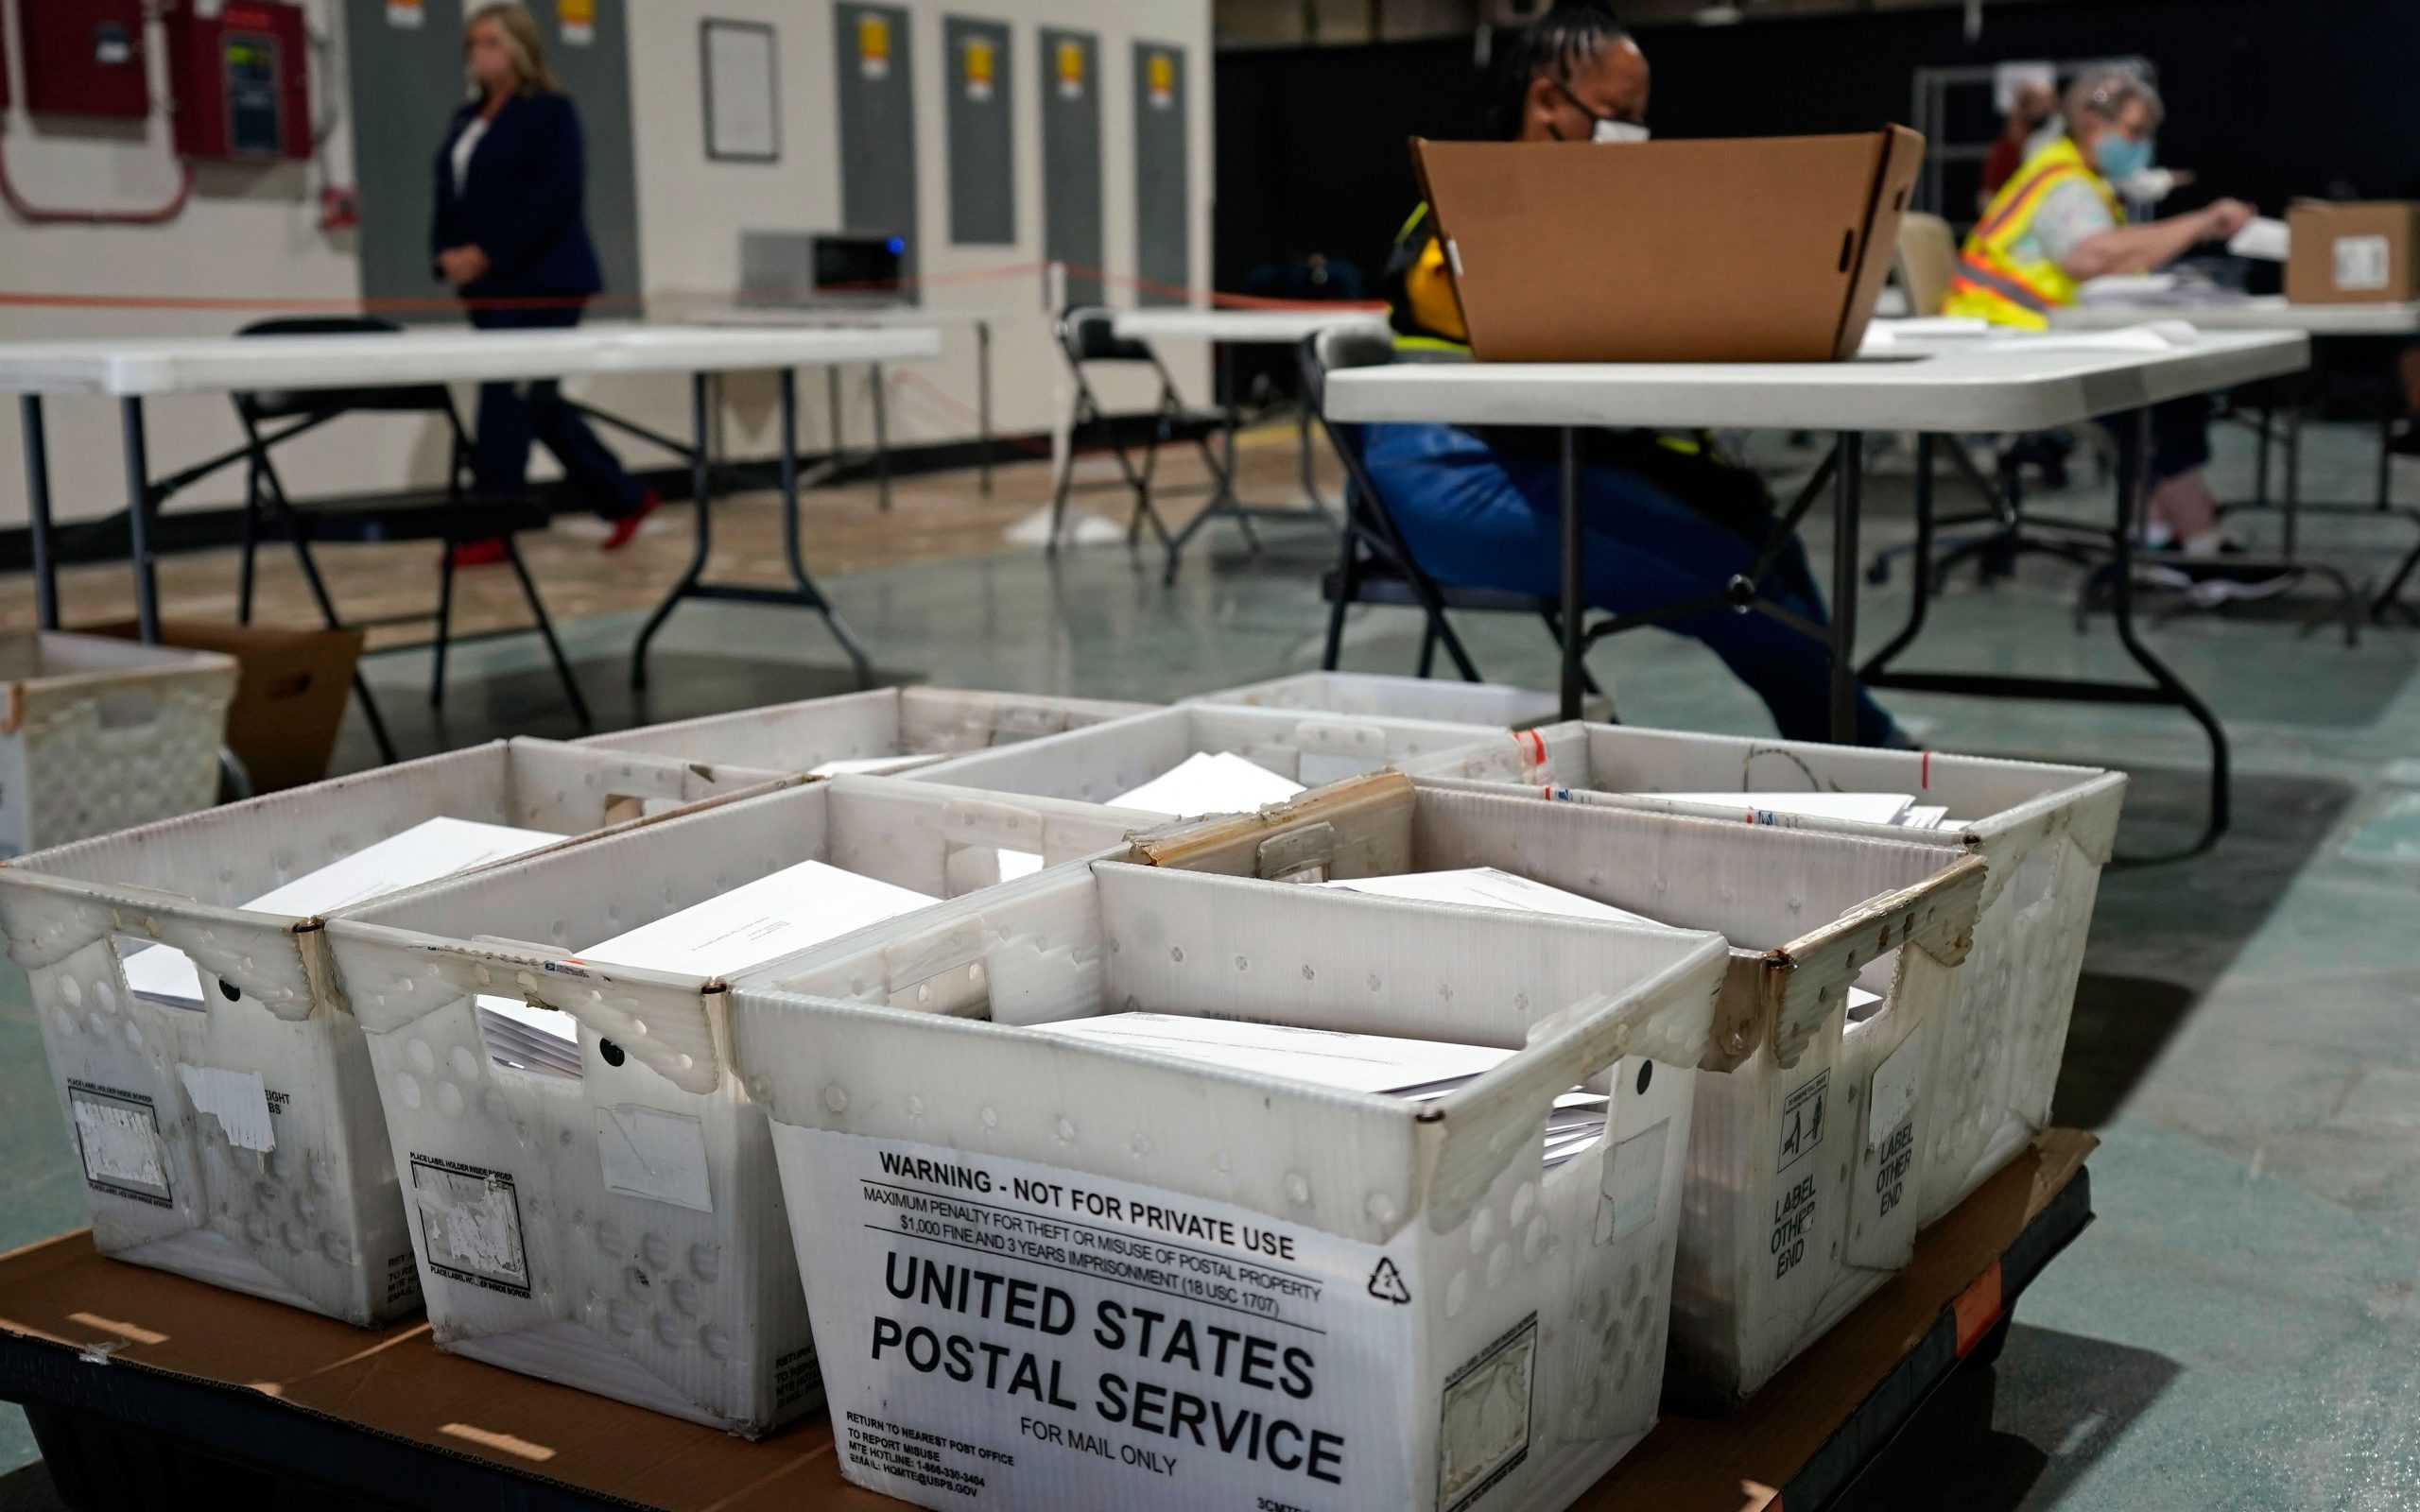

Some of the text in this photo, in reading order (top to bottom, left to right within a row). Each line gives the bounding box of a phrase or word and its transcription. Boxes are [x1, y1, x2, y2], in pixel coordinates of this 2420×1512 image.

[265, 1089, 290, 1105] EIGHT
[1880, 1122, 1913, 1165] LABEL
[1876, 1147, 1911, 1194] OTHER
[879, 1151, 992, 1193] WARNING
[1013, 1177, 1063, 1208] NOT
[1072, 1189, 1123, 1221] FOR
[1130, 1202, 1236, 1246] PRIVATE
[1243, 1227, 1296, 1262] USE
[1773, 1174, 1816, 1225] LABEL
[1879, 1181, 1902, 1217] END
[864, 1187, 1322, 1302] MAXIMUM PENALTY FOR THEFT OR MISUSE OF POSTAL PROPERTY
[900, 1214, 1280, 1319] $1,000 FINE AND 3 YEARS IMPRISONMENT (18 USC 1707)
[1776, 1238, 1804, 1280] END
[885, 1251, 1315, 1400] UNITED STATES
[872, 1315, 1078, 1411] POSTAL
[1095, 1373, 1345, 1486] SERVICE
[846, 1411, 1015, 1467] RETURN TO NEAREST POST OFFICE
[847, 1427, 940, 1463] TO REPORT MISUSE
[849, 1440, 869, 1455] MTE
[870, 1446, 915, 1469] HOTLINE:
[849, 1452, 881, 1470] EMAIL:
[1020, 1417, 1178, 1476] FOR MAIL ONLY
